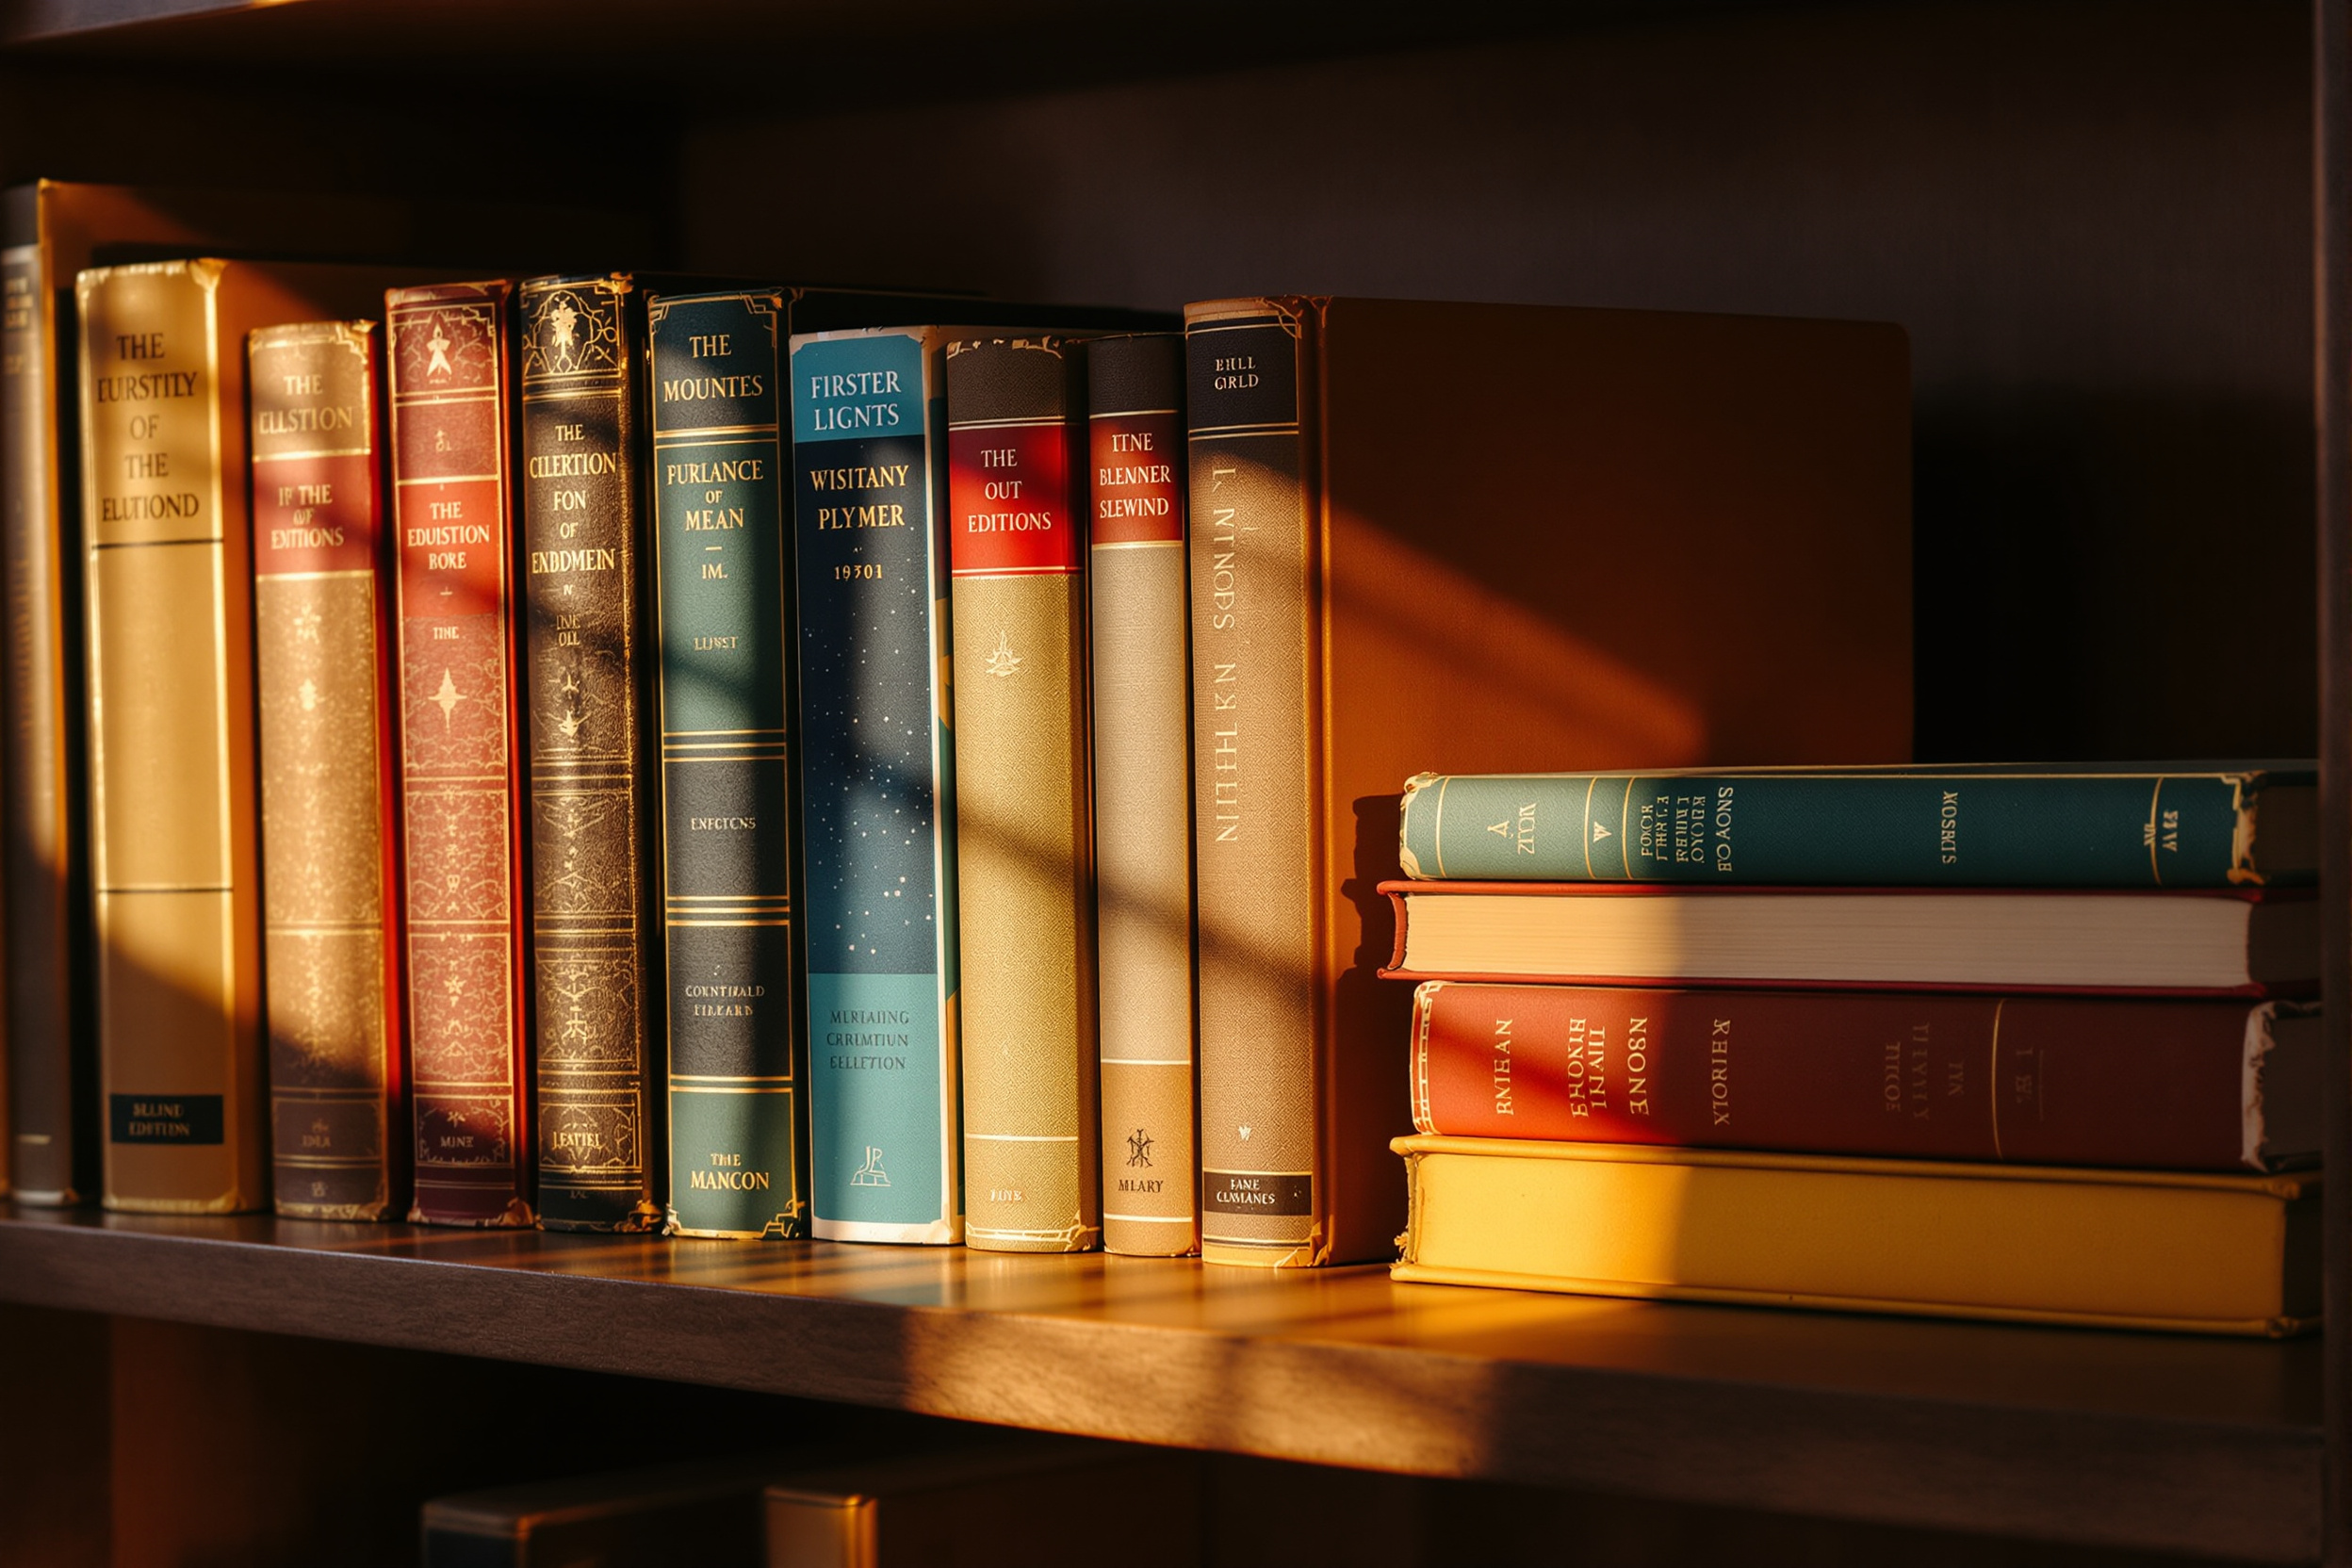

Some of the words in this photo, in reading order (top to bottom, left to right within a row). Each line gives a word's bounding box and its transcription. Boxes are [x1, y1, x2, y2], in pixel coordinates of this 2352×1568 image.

[116, 332, 165, 360] THE
[690, 335, 732, 359] THE
[283, 374, 323, 396] THE
[663, 375, 764, 403] MOUNTES
[810, 371, 901, 399] FIRSTER
[130, 415, 159, 441] OF
[555, 424, 584, 441] THE
[124, 452, 169, 479] THE
[981, 449, 1018, 467] THE
[667, 460, 764, 486] PURLANCE
[809, 465, 909, 491] WISITANY
[1100, 466, 1171, 486] BLENNER
[298, 483, 333, 505] THE
[553, 490, 586, 511] FON
[705, 490, 724, 504] OF
[984, 481, 1022, 499] OUT
[430, 501, 463, 519] THE
[818, 505, 906, 530] PLYMER
[1100, 498, 1169, 519] SLEWIND
[685, 508, 744, 531] MEAN
[968, 513, 1052, 532] EDITIONS
[560, 522, 579, 539] OF
[710, 1153, 742, 1167] THE
[691, 1170, 769, 1190] MANCON
